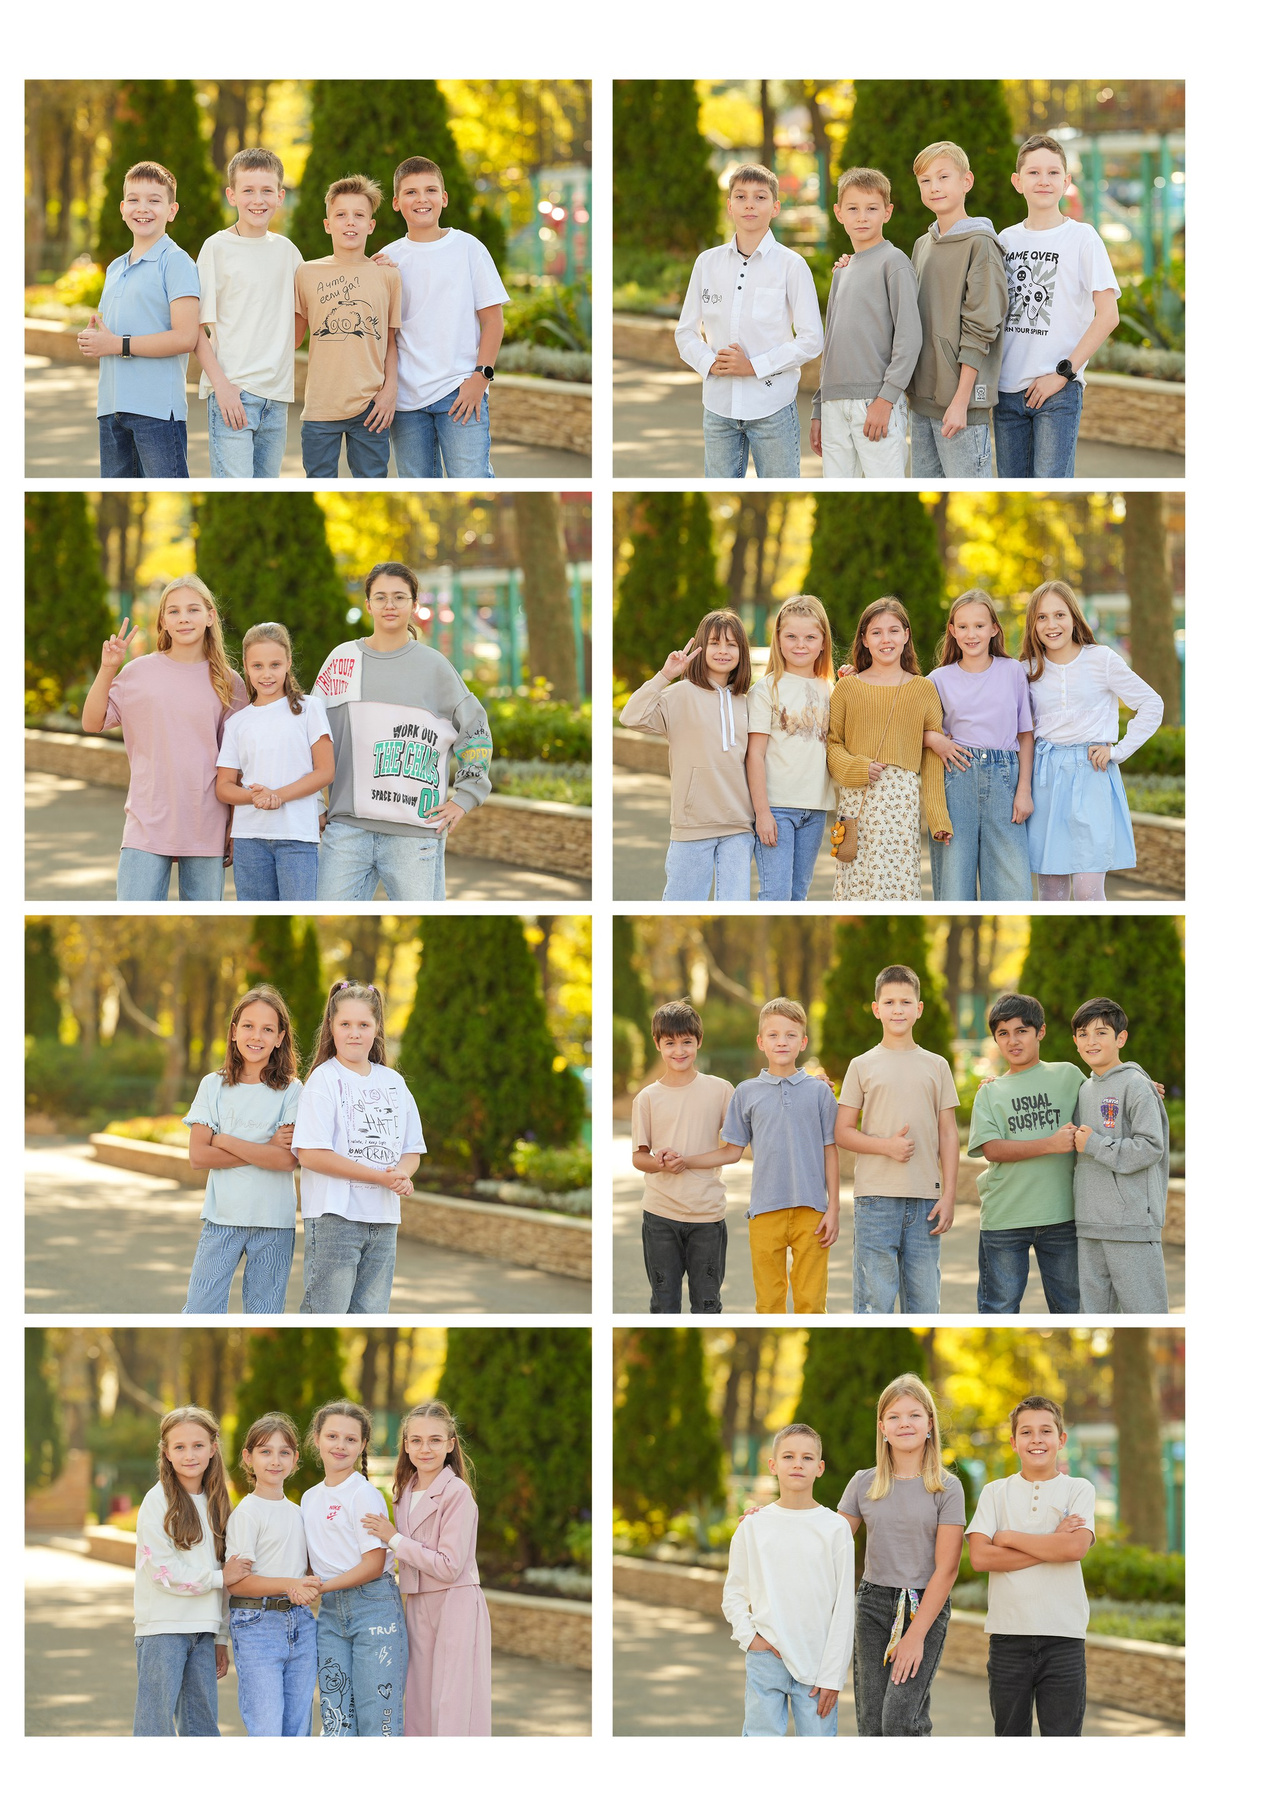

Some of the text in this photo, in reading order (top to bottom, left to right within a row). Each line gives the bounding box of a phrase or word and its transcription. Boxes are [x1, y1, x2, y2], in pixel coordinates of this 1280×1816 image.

[1030, 251, 1059, 265] OVER
[320, 290, 340, 304] если
[332, 658, 355, 678] YOUR
[393, 723, 439, 747] WORK OUT
[373, 740, 405, 778] THE
[371, 788, 392, 802] SPACE
[393, 791, 401, 802] TO
[1011, 1093, 1052, 1114] USUAL
[363, 1113, 400, 1139] HATE
[1008, 1109, 1060, 1134] SUSPECT
[369, 1622, 398, 1636] TRUE
